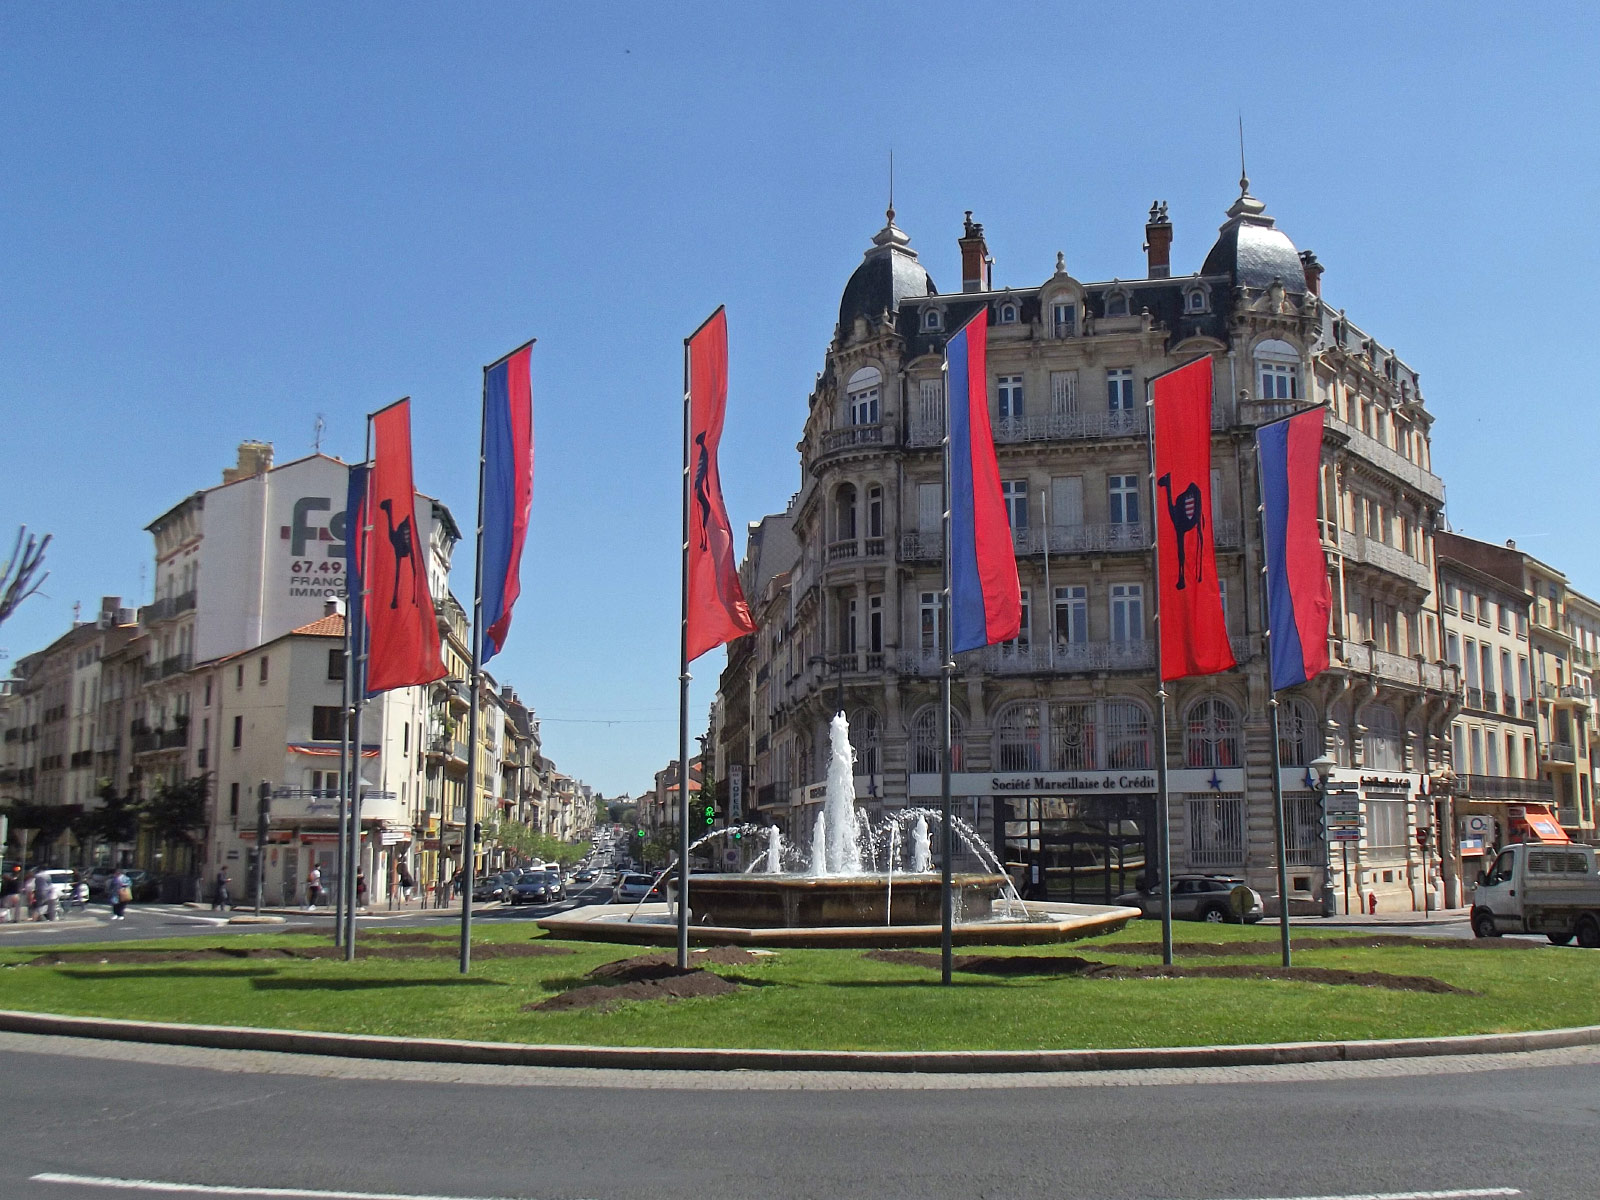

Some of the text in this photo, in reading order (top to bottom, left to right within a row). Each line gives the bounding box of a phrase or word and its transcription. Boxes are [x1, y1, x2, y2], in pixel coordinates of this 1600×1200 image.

[992, 775, 1155, 790] Société Marseillaise de Crédit
